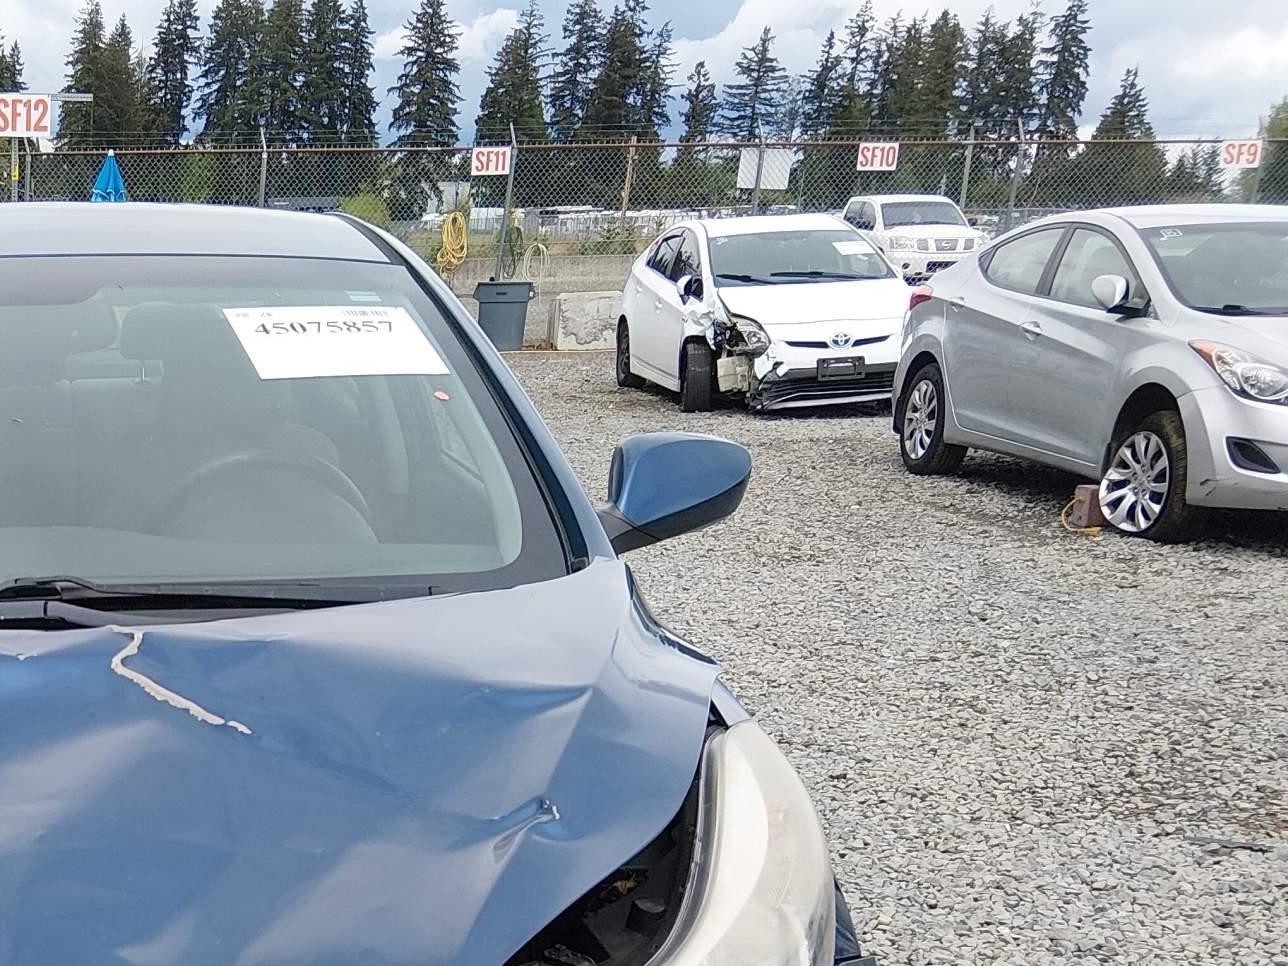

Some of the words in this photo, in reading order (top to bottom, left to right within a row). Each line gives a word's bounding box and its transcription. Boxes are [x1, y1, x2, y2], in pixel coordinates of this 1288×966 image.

[475, 150, 507, 172] SF11
[859, 145, 897, 168] SF10
[1223, 143, 1258, 165] SF9
[255, 320, 393, 335] 45075857
